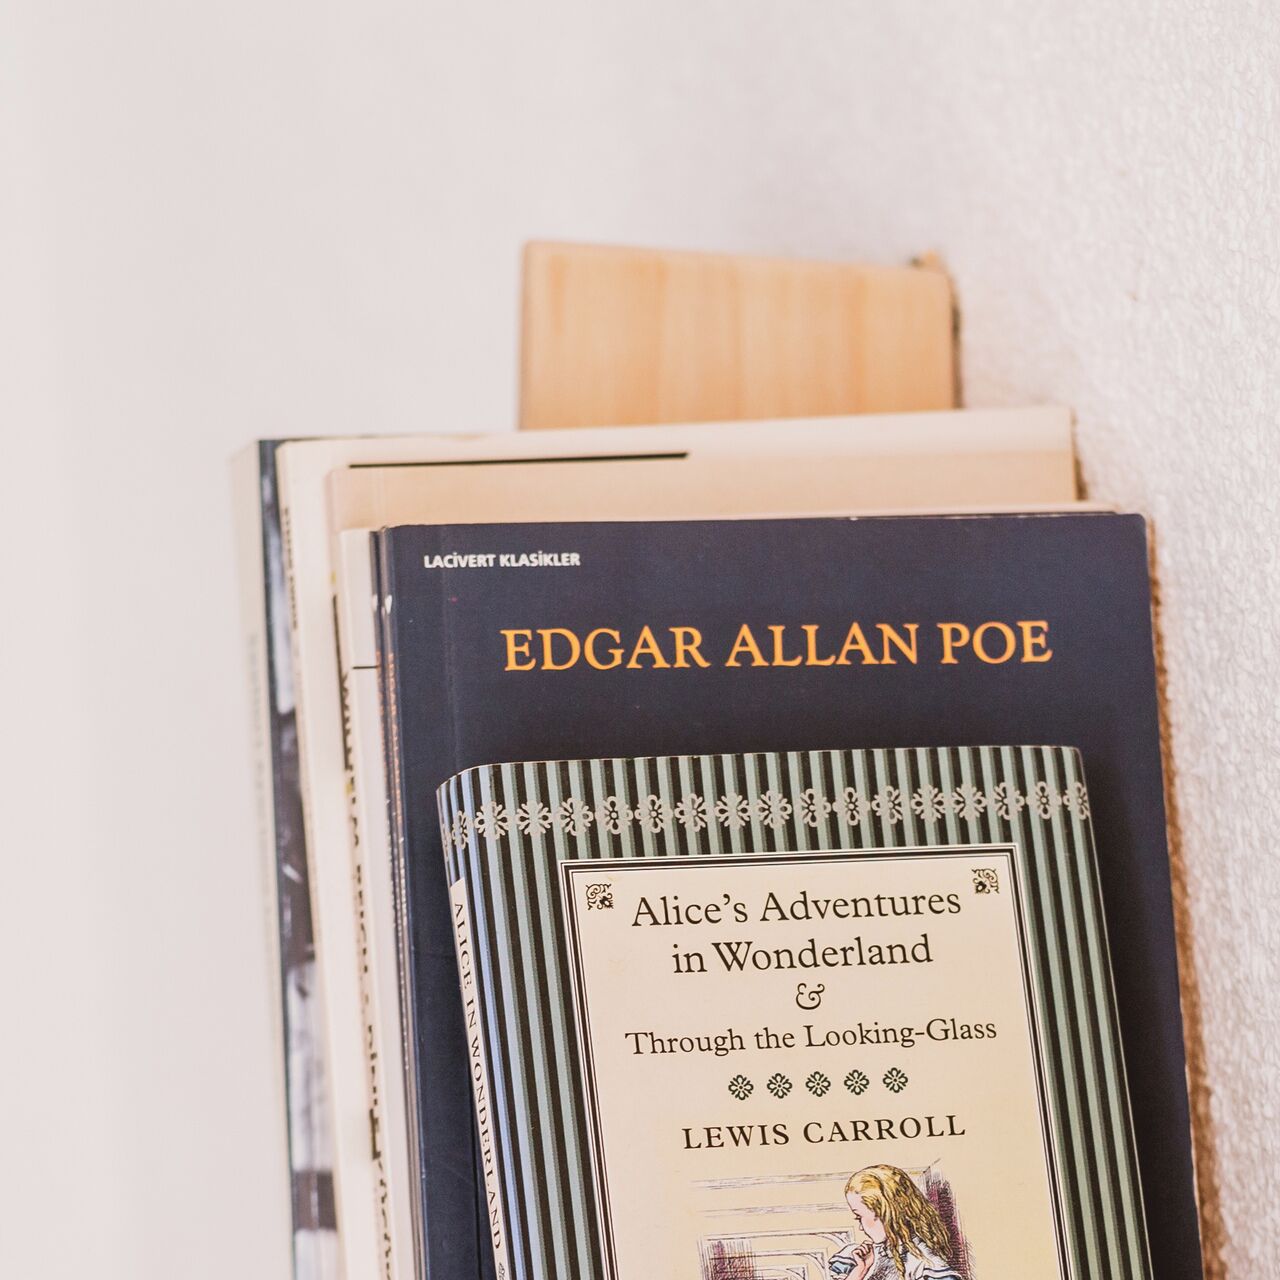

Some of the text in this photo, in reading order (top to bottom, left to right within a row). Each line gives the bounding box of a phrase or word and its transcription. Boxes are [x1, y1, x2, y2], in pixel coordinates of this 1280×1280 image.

[423, 550, 581, 569] LACİVERT KLASİKLER
[499, 620, 1053, 672] EDGAR ALLAN POE
[631, 890, 961, 927] Alice's Adventures
[671, 933, 934, 974] in Wonderland
[795, 982, 826, 1011] &
[624, 1018, 997, 1057] Through the Looking-Glass
[455, 902, 472, 990] ALICE
[466, 999, 477, 1030] IN
[472, 1036, 501, 1250] WONDERLAND
[681, 1114, 966, 1150] LEWIS CARROLL
